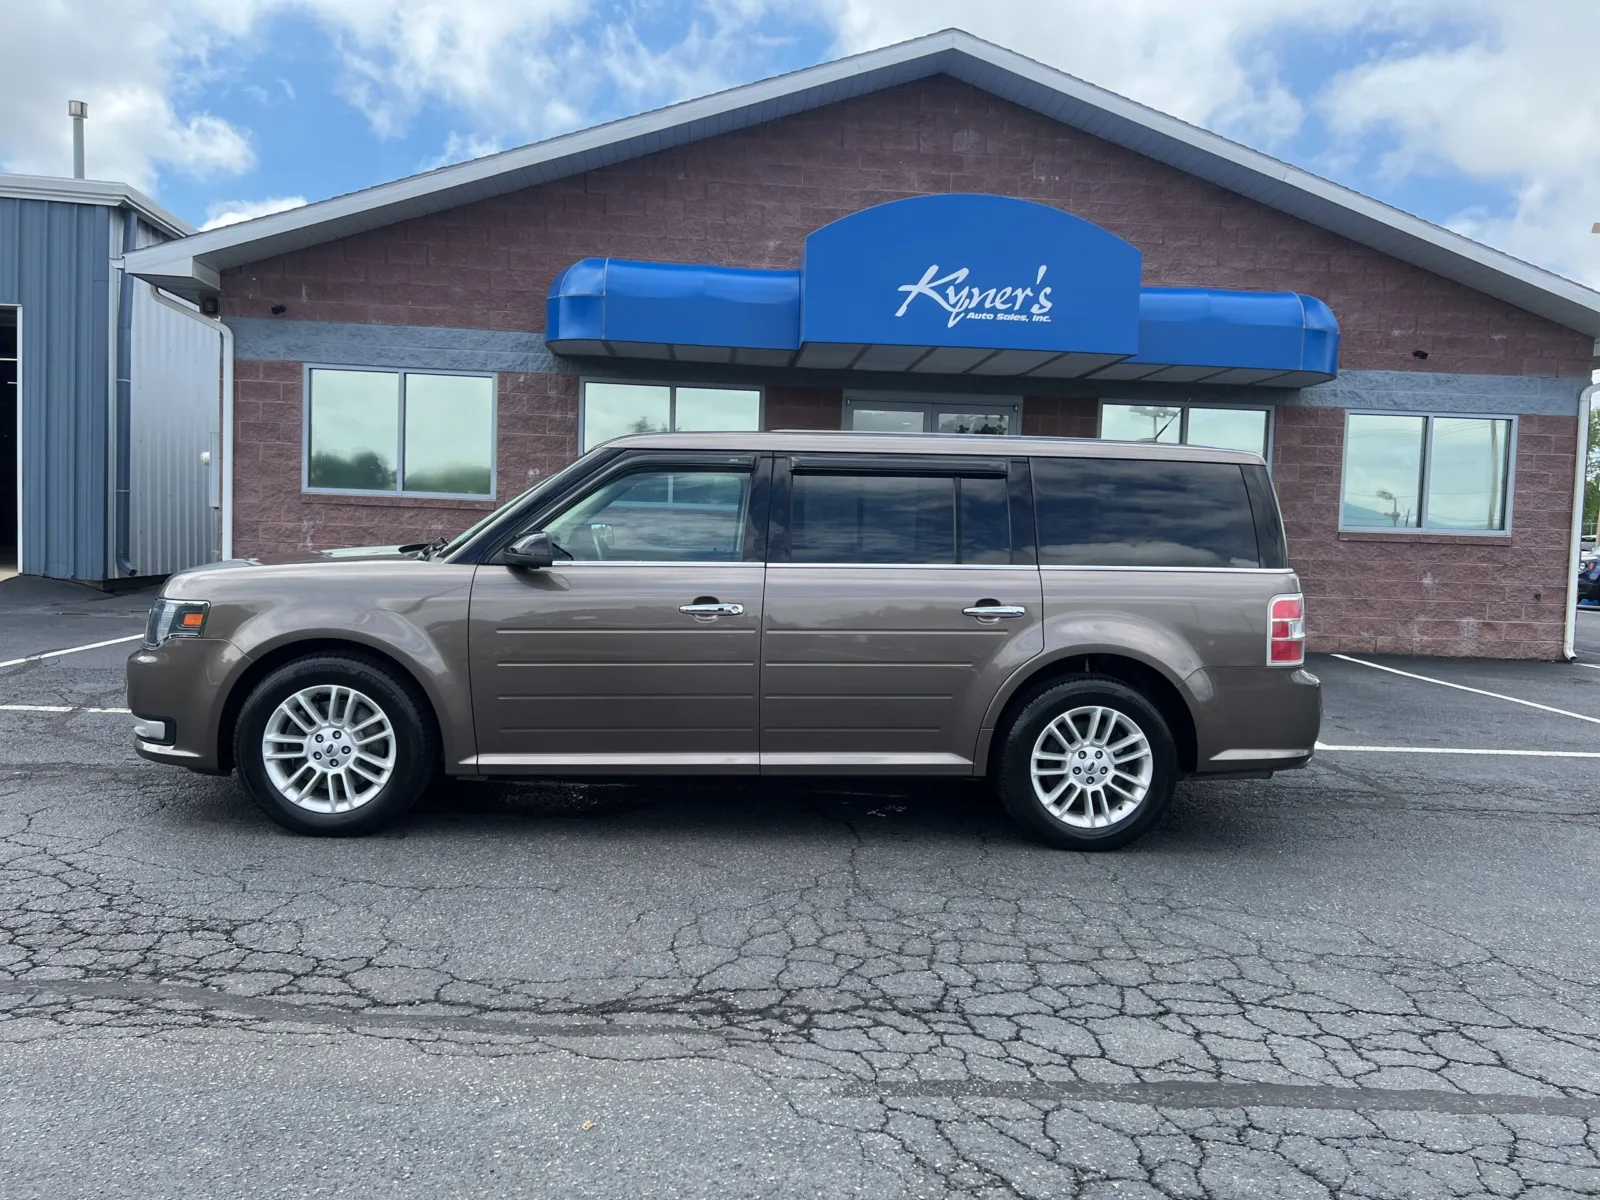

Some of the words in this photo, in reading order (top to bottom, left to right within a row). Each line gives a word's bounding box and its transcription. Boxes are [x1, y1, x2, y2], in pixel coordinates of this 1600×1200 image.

[895, 264, 1053, 328] Kyner's
[966, 312, 994, 320] Auto
[996, 313, 1029, 323] Sales,
[1032, 314, 1052, 323] Inc.
